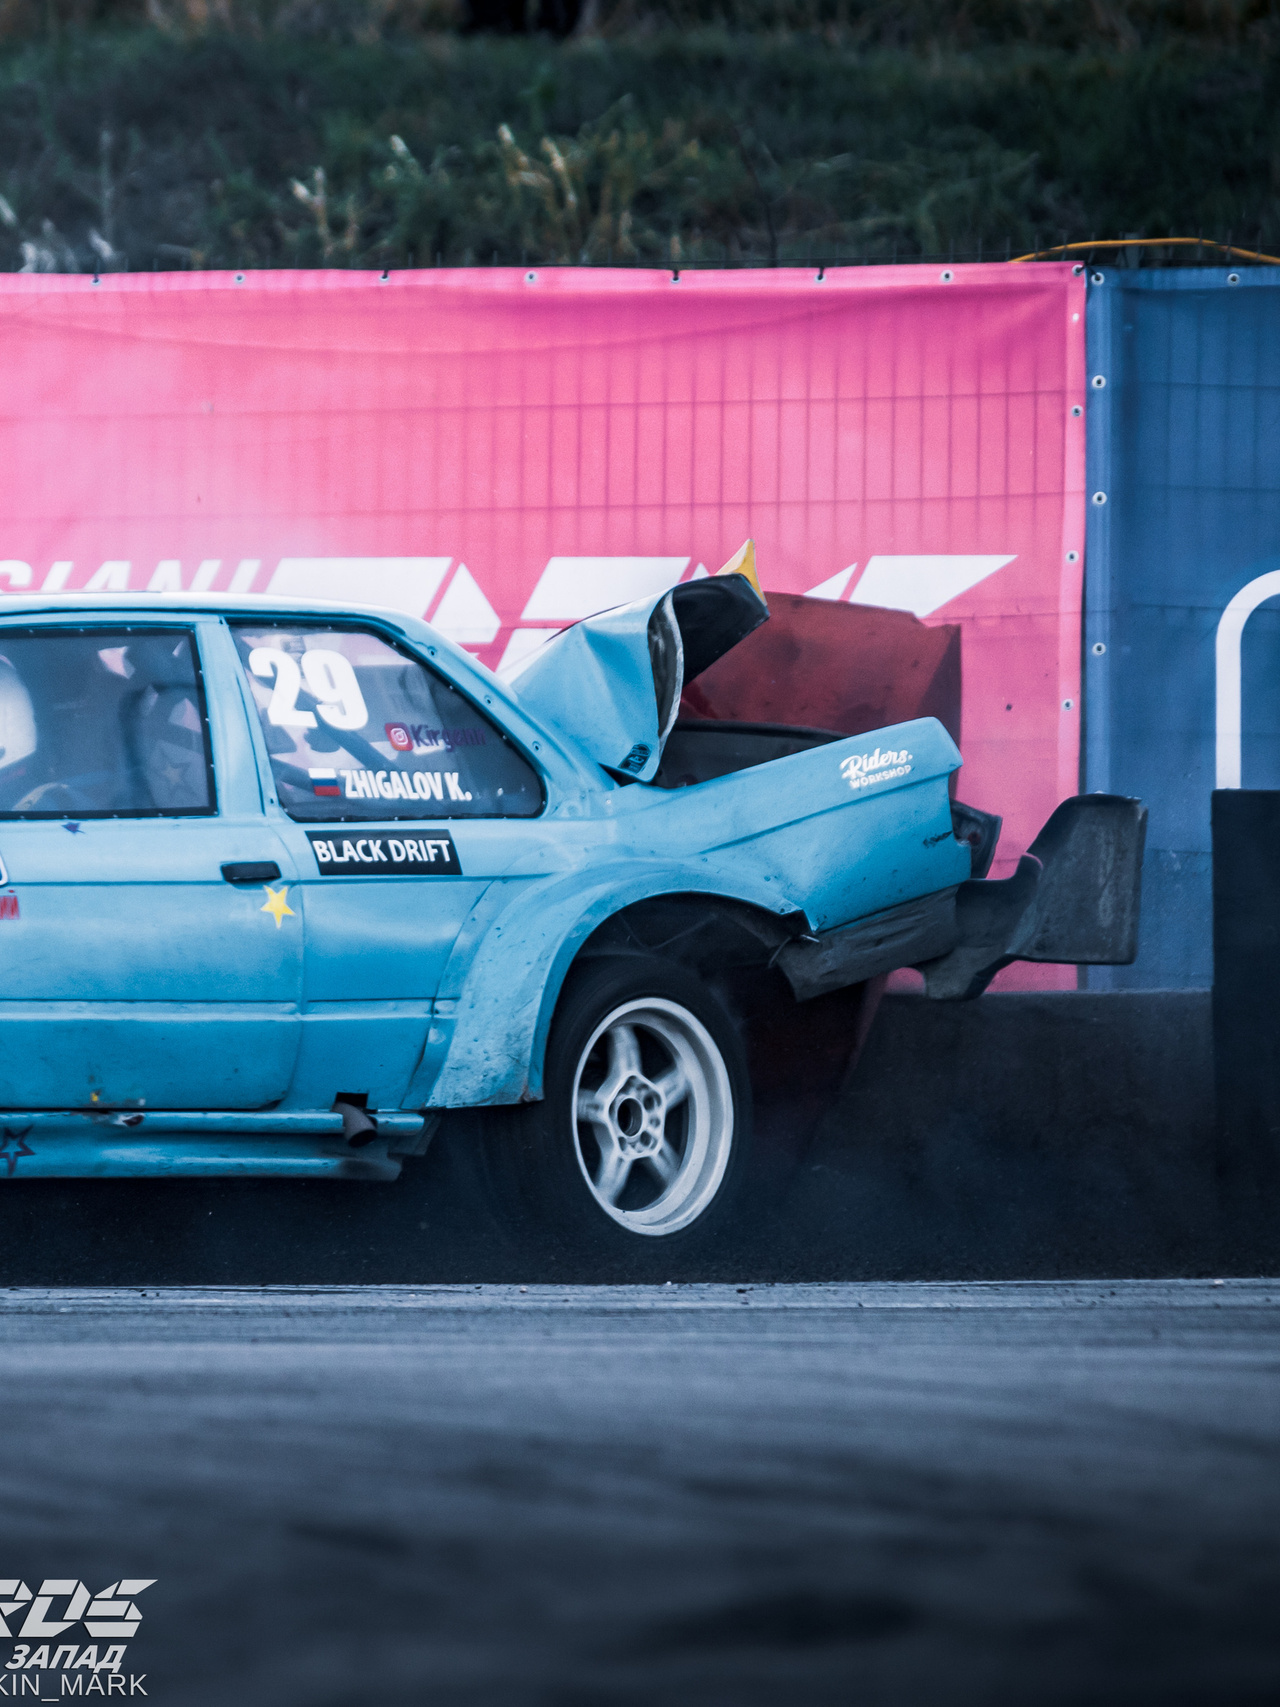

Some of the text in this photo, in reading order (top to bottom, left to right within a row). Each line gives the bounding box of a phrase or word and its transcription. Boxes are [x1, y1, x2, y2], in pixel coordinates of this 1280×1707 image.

[248, 647, 369, 730] 29
[340, 770, 472, 801] ZHIGALOV K.
[849, 765, 912, 789] WORKSHOP
[312, 839, 451, 863] BLACK DRIFT
